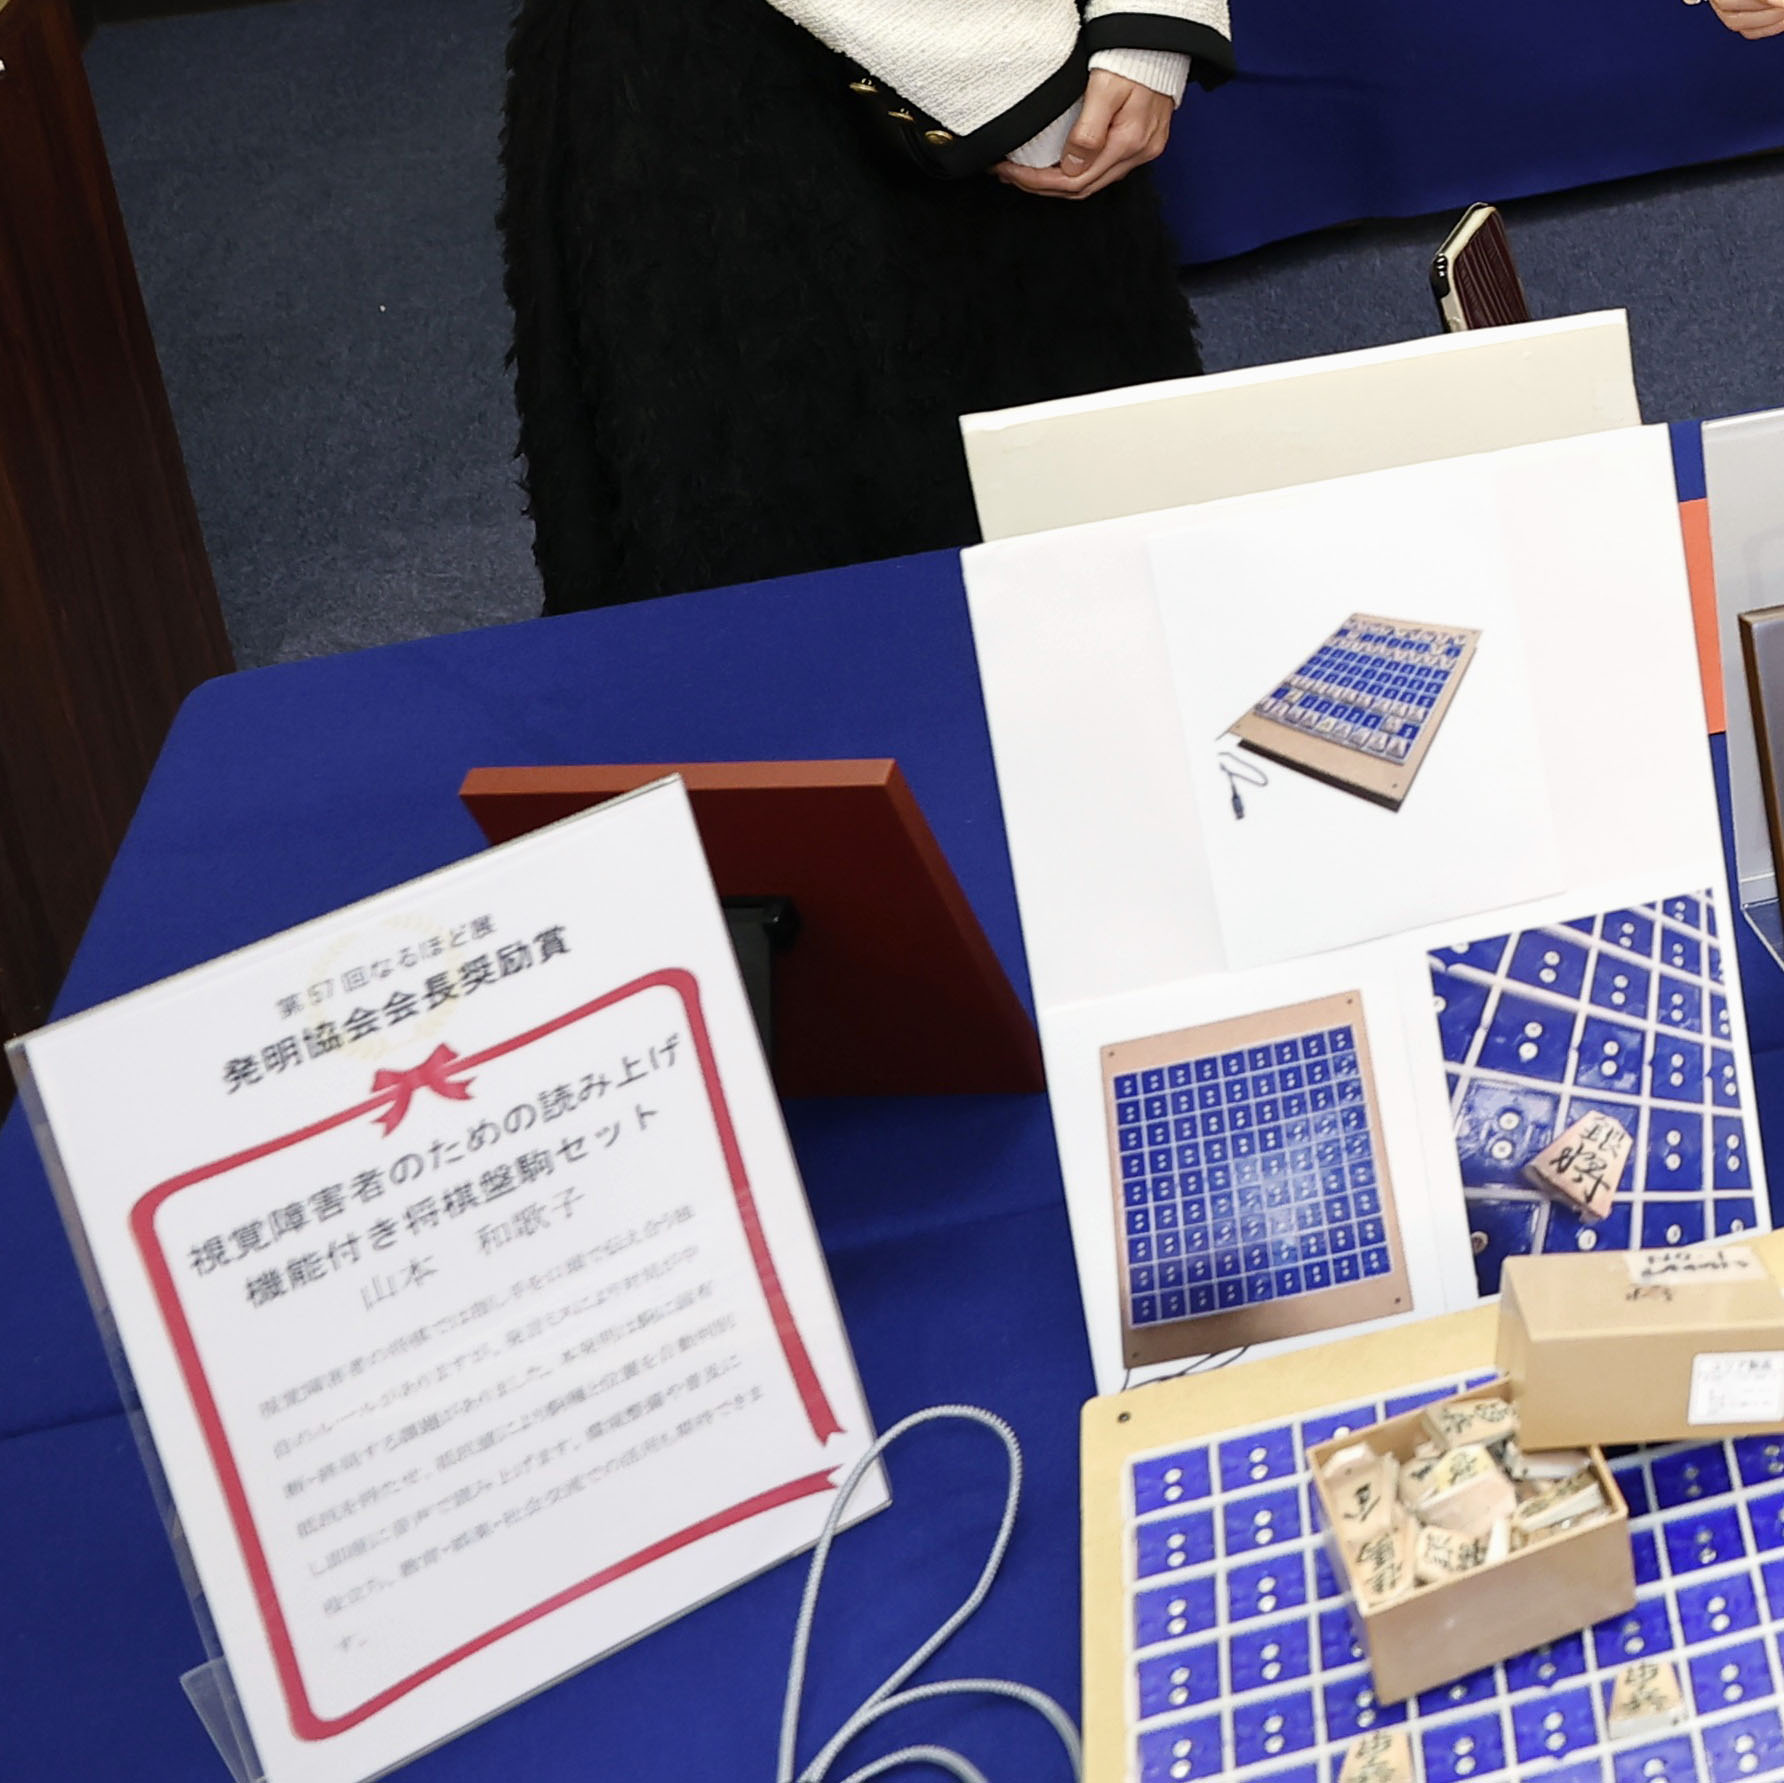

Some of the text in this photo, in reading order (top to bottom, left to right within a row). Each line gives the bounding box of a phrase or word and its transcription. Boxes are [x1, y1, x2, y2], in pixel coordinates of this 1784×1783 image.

[219, 920, 574, 1095] 発明協会会長奨励賞
[275, 910, 498, 1021] 第57回なるほど展
[184, 1031, 685, 1279] 視覚障害者のための読み上げ
[240, 1096, 662, 1312] 機能付き将棋盤駒セット
[356, 1183, 590, 1309] 山本 和歌子
